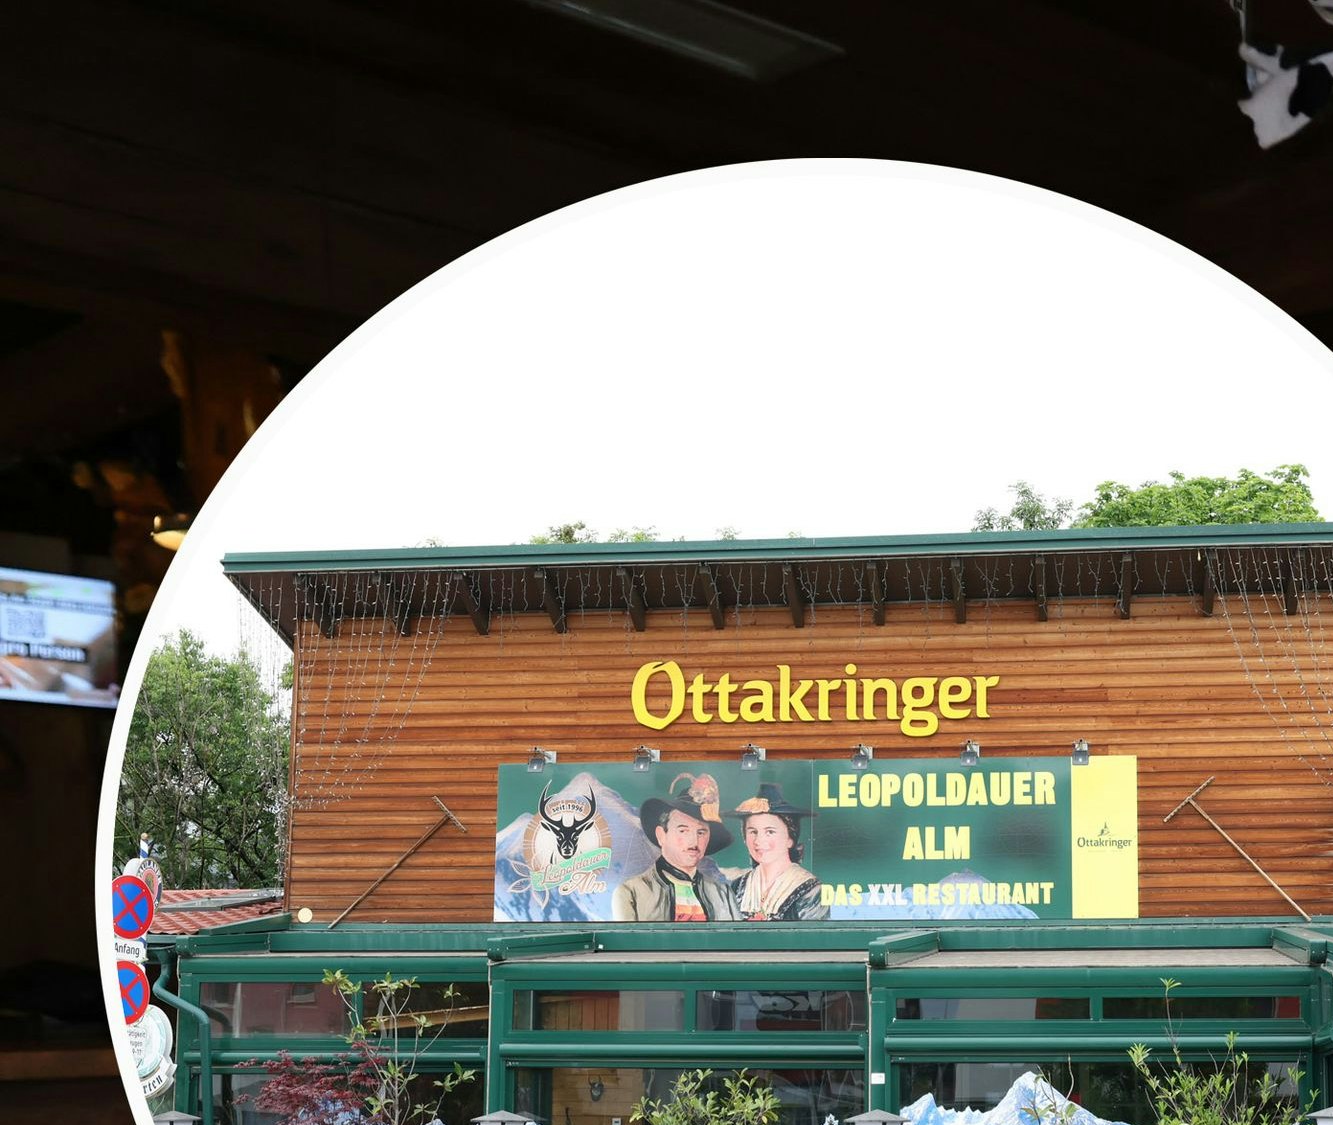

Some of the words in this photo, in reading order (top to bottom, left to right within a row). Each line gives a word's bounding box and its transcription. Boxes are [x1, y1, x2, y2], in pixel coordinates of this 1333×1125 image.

[631, 660, 999, 737] Ottakringer
[818, 771, 1056, 807] LEOPOLDAUER
[902, 826, 970, 860] ALM
[1077, 837, 1132, 849] Ottakringer
[821, 883, 864, 906] DAS
[868, 883, 907, 905] XXL
[912, 881, 1054, 905] RESTAURANT
[114, 941, 140, 958] Anfang
